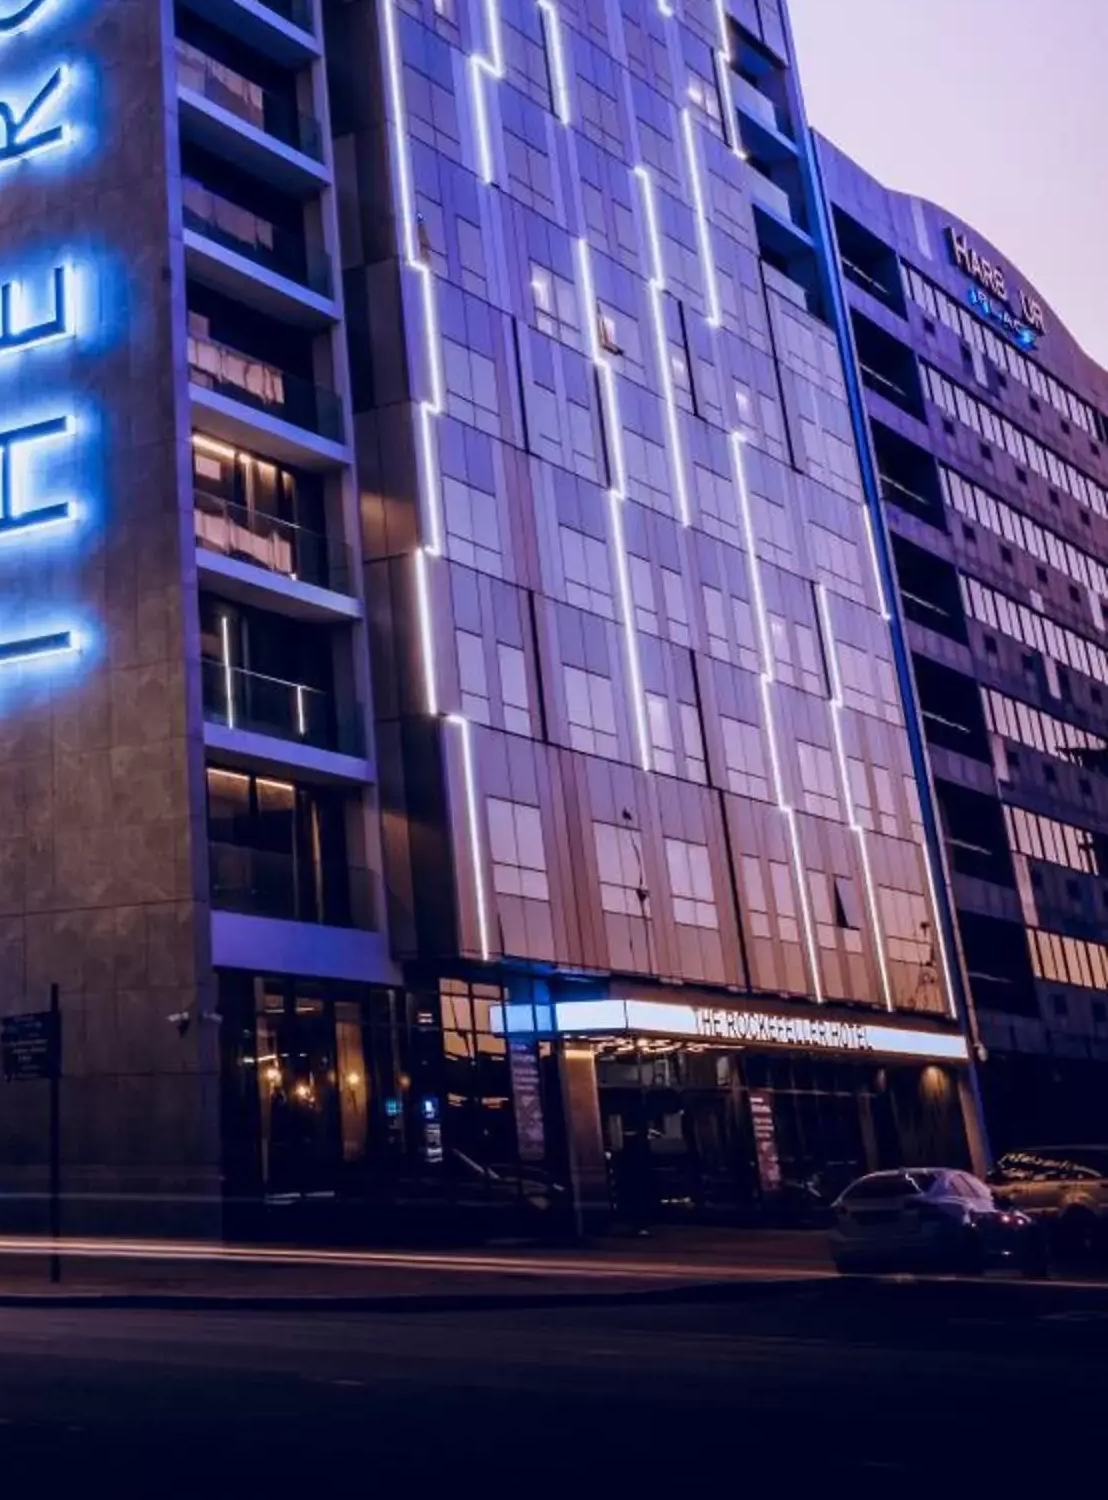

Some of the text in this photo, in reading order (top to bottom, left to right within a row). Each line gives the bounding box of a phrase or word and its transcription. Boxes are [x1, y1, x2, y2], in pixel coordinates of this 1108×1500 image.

[694, 1008, 874, 1052] THE ROCKEFELLER HOTEL
